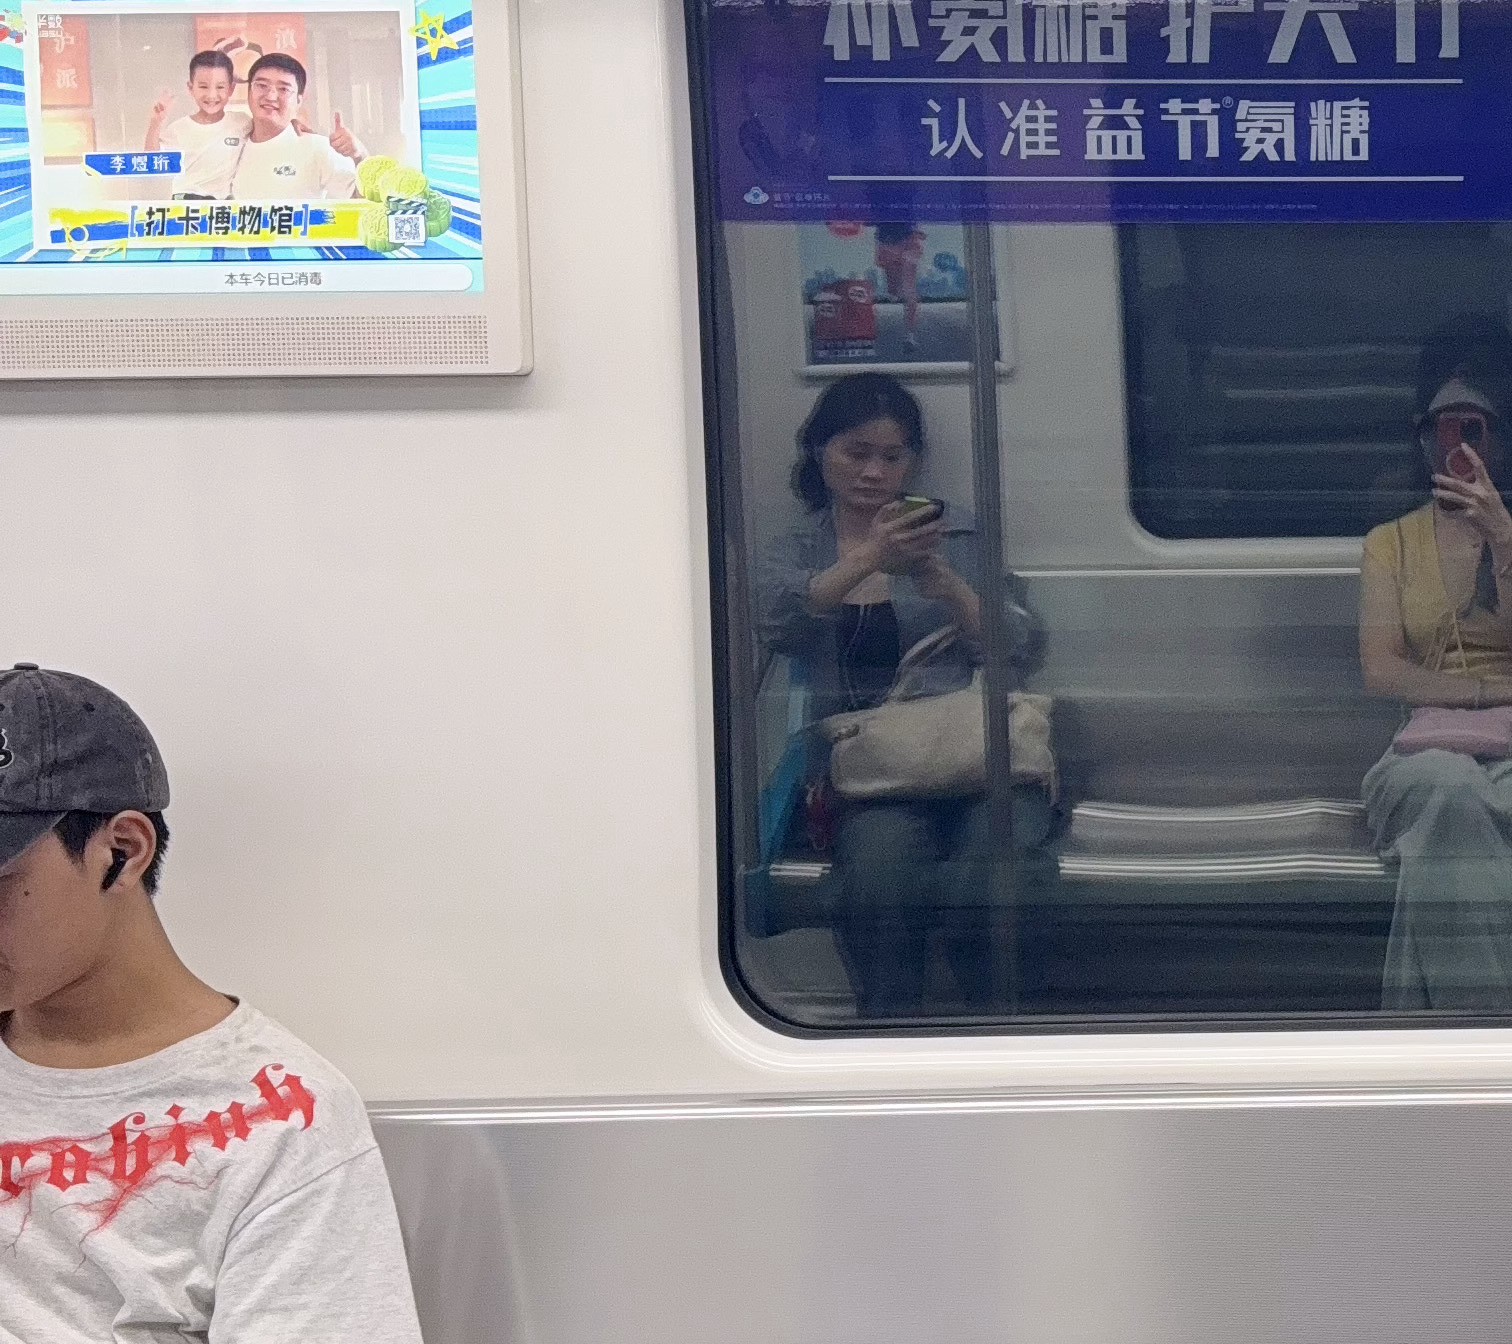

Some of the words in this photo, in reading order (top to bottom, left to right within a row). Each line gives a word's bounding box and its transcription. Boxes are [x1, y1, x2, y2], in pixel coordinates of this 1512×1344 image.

[223, 272, 323, 288] 本车今日已消毒
